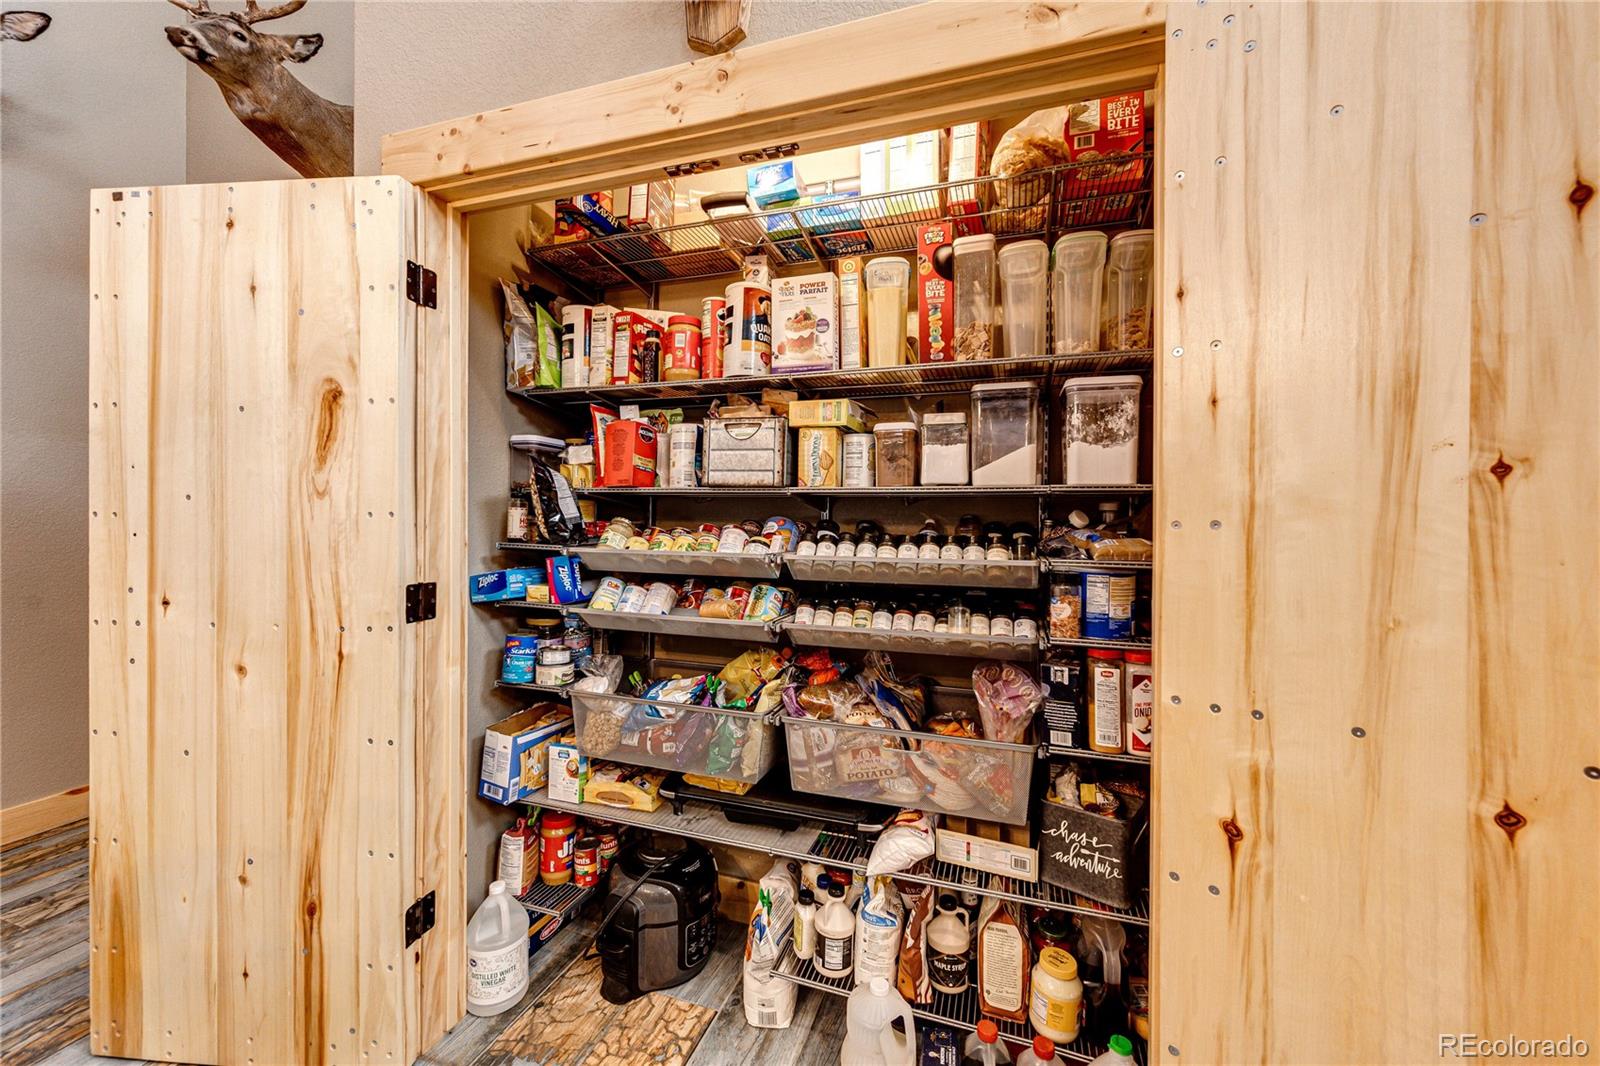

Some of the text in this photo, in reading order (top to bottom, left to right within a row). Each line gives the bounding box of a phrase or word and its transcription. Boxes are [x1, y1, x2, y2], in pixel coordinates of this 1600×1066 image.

[1107, 98, 1140, 110] BEST IN
[1107, 105, 1140, 119] EVERY
[1107, 114, 1141, 131] BITE
[799, 281, 826, 289] POWER
[799, 287, 828, 295] PARFAIT
[925, 289, 945, 298] BITE
[750, 323, 771, 334] QUA
[478, 574, 499, 588] Ziploc
[558, 565, 572, 591] Ziploc
[1134, 707, 1152, 718] ONIO
[847, 768, 894, 780] POTATO
[1041, 820, 1113, 848] chase
[1050, 842, 1123, 879] adventure
[934, 960, 951, 971] MAPLE
[471, 964, 516, 981] DISTILLED WHITE
[480, 976, 506, 987] VINEGAR
